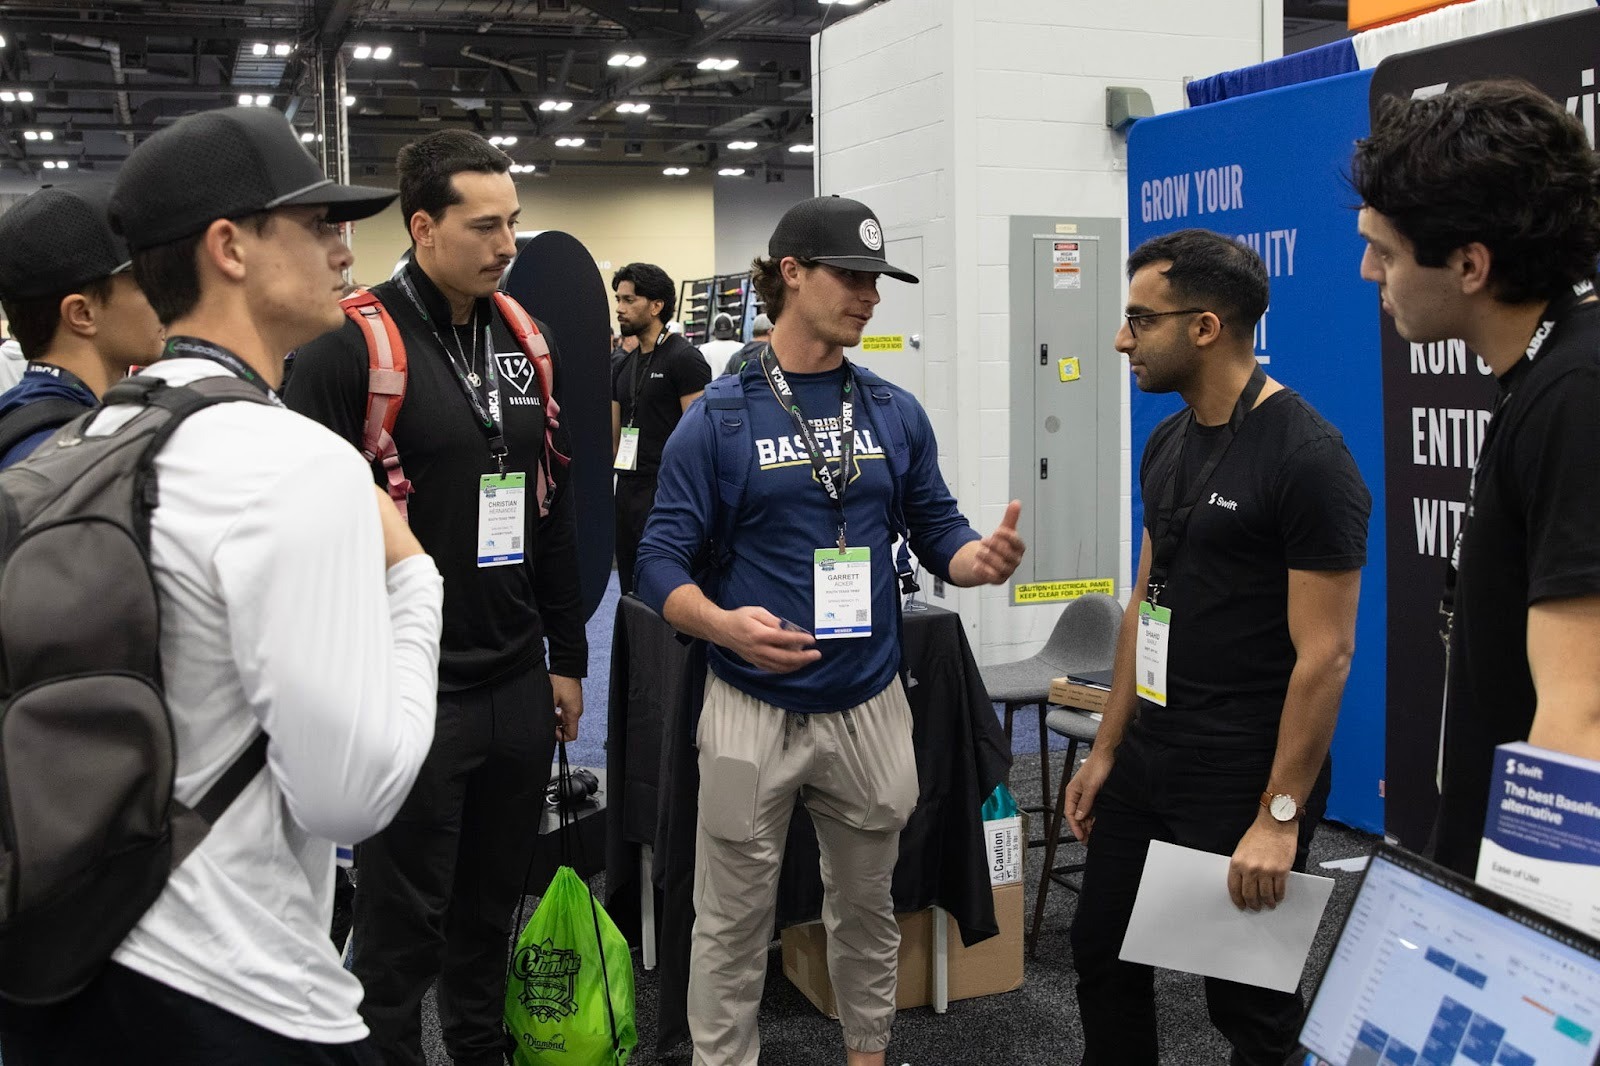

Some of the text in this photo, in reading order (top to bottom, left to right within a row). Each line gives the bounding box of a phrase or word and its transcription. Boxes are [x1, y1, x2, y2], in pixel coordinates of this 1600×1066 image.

[1141, 164, 1244, 223] GROW YOUR
[1525, 321, 1555, 361] ABCA
[503, 358, 530, 378] 1%
[1410, 338, 1467, 375] RUN
[771, 366, 793, 396] ABCA
[489, 389, 500, 422] ABCA
[509, 397, 540, 406] BASEBALL
[808, 416, 841, 431] RIB
[843, 402, 853, 433] ABCA
[756, 429, 886, 465] BASEBAL
[819, 465, 838, 499] ABCA
[488, 500, 517, 508] CHRISTIAN
[1216, 496, 1238, 511] Swift
[1413, 497, 1466, 558] WIT
[827, 573, 860, 581] GARRETT
[1089, 580, 1110, 588] PANEL
[1516, 762, 1544, 781] Swift
[1504, 780, 1528, 799] The
[1527, 787, 1555, 806] best
[1500, 798, 1563, 826] alternative
[993, 832, 1004, 871] Caution
[1492, 861, 1540, 885] Ease of Use
[523, 1033, 566, 1050] Diamond
